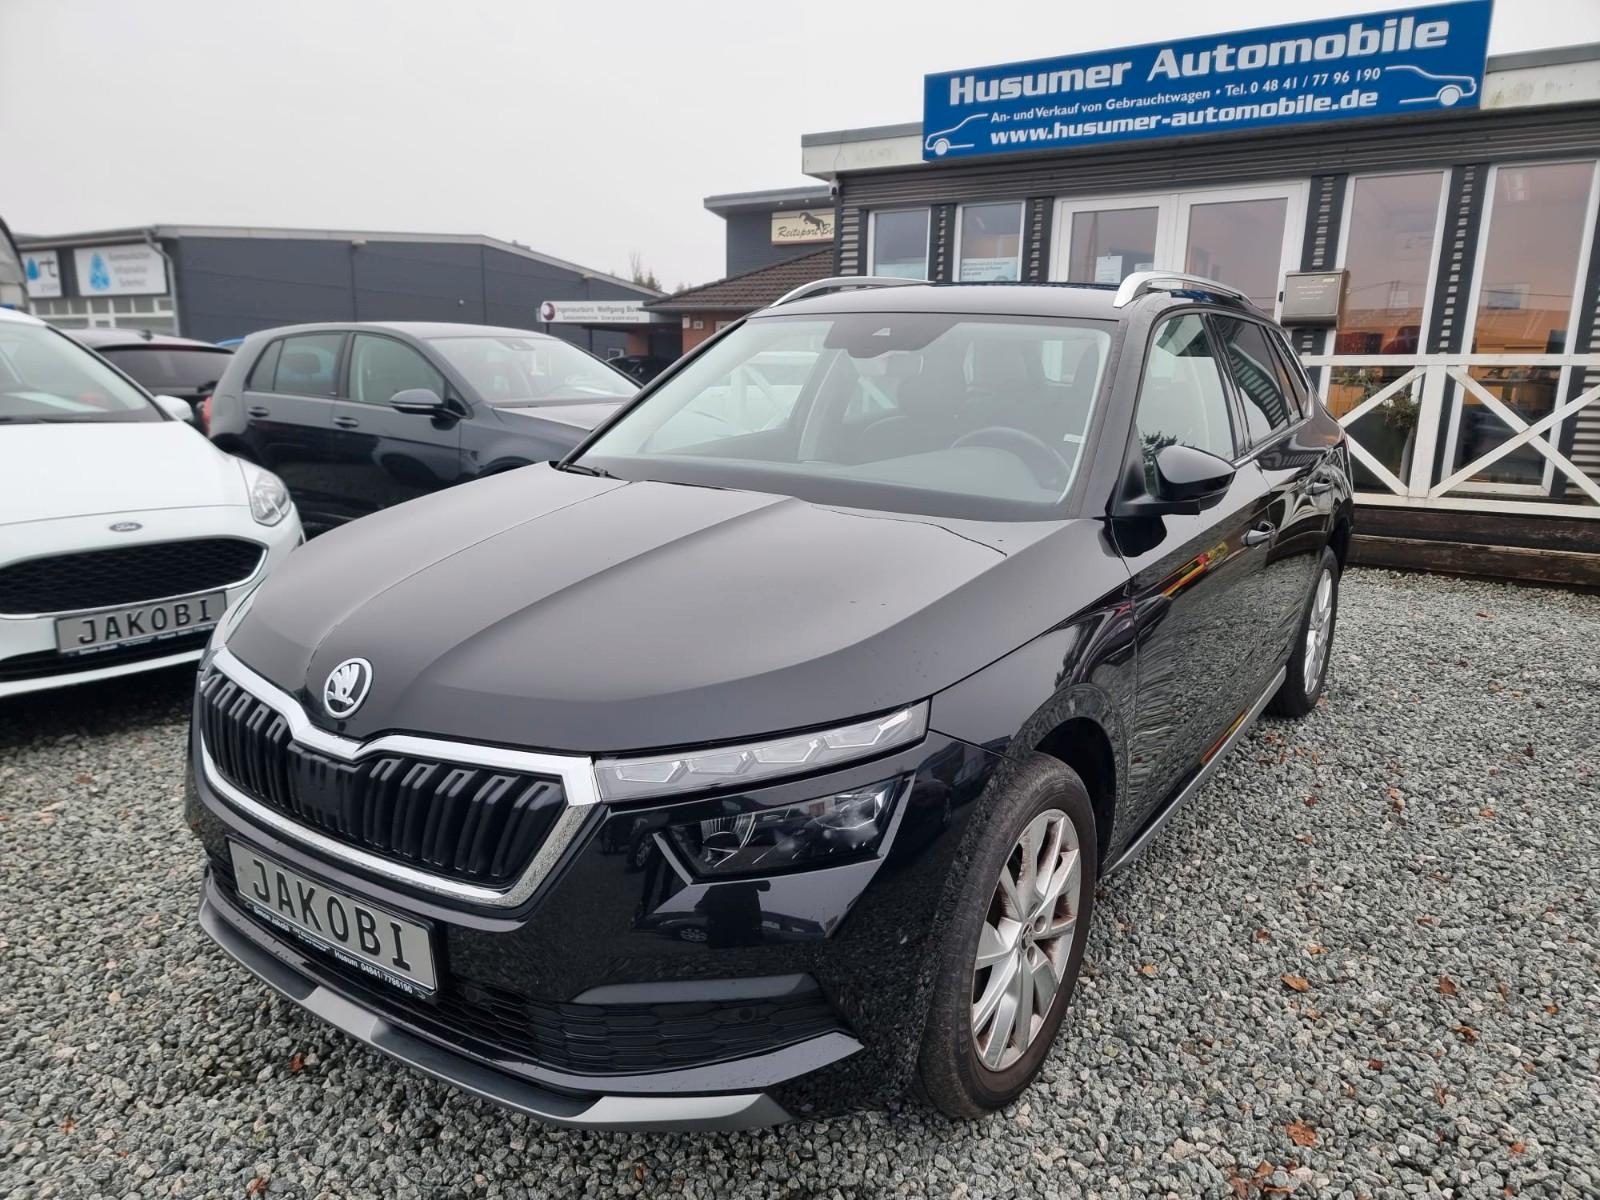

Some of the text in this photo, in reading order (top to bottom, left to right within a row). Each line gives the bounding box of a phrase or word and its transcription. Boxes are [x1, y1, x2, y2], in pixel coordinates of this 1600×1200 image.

[949, 16, 1450, 106] Husumer Automobile
[990, 111, 1011, 124] An-
[1013, 108, 1034, 120] und
[1035, 103, 1079, 118] Verkauf
[1082, 102, 1102, 113] von
[1105, 89, 1210, 111] Gebrauchtwagen
[1225, 84, 1247, 96] Tel.
[1250, 81, 1258, 93] 0
[1262, 79, 1279, 92] 48
[1282, 77, 1297, 91] 41
[1313, 73, 1328, 86] 77
[1333, 71, 1350, 84] 96
[1356, 67, 1380, 82] 190
[990, 89, 1379, 145] www.husumer-automobile.de
[778, 224, 820, 239] Reitsport
[78, 600, 211, 644] JAKOBI
[253, 859, 411, 972] JAKOBI
[334, 949, 359, 968] Husum
